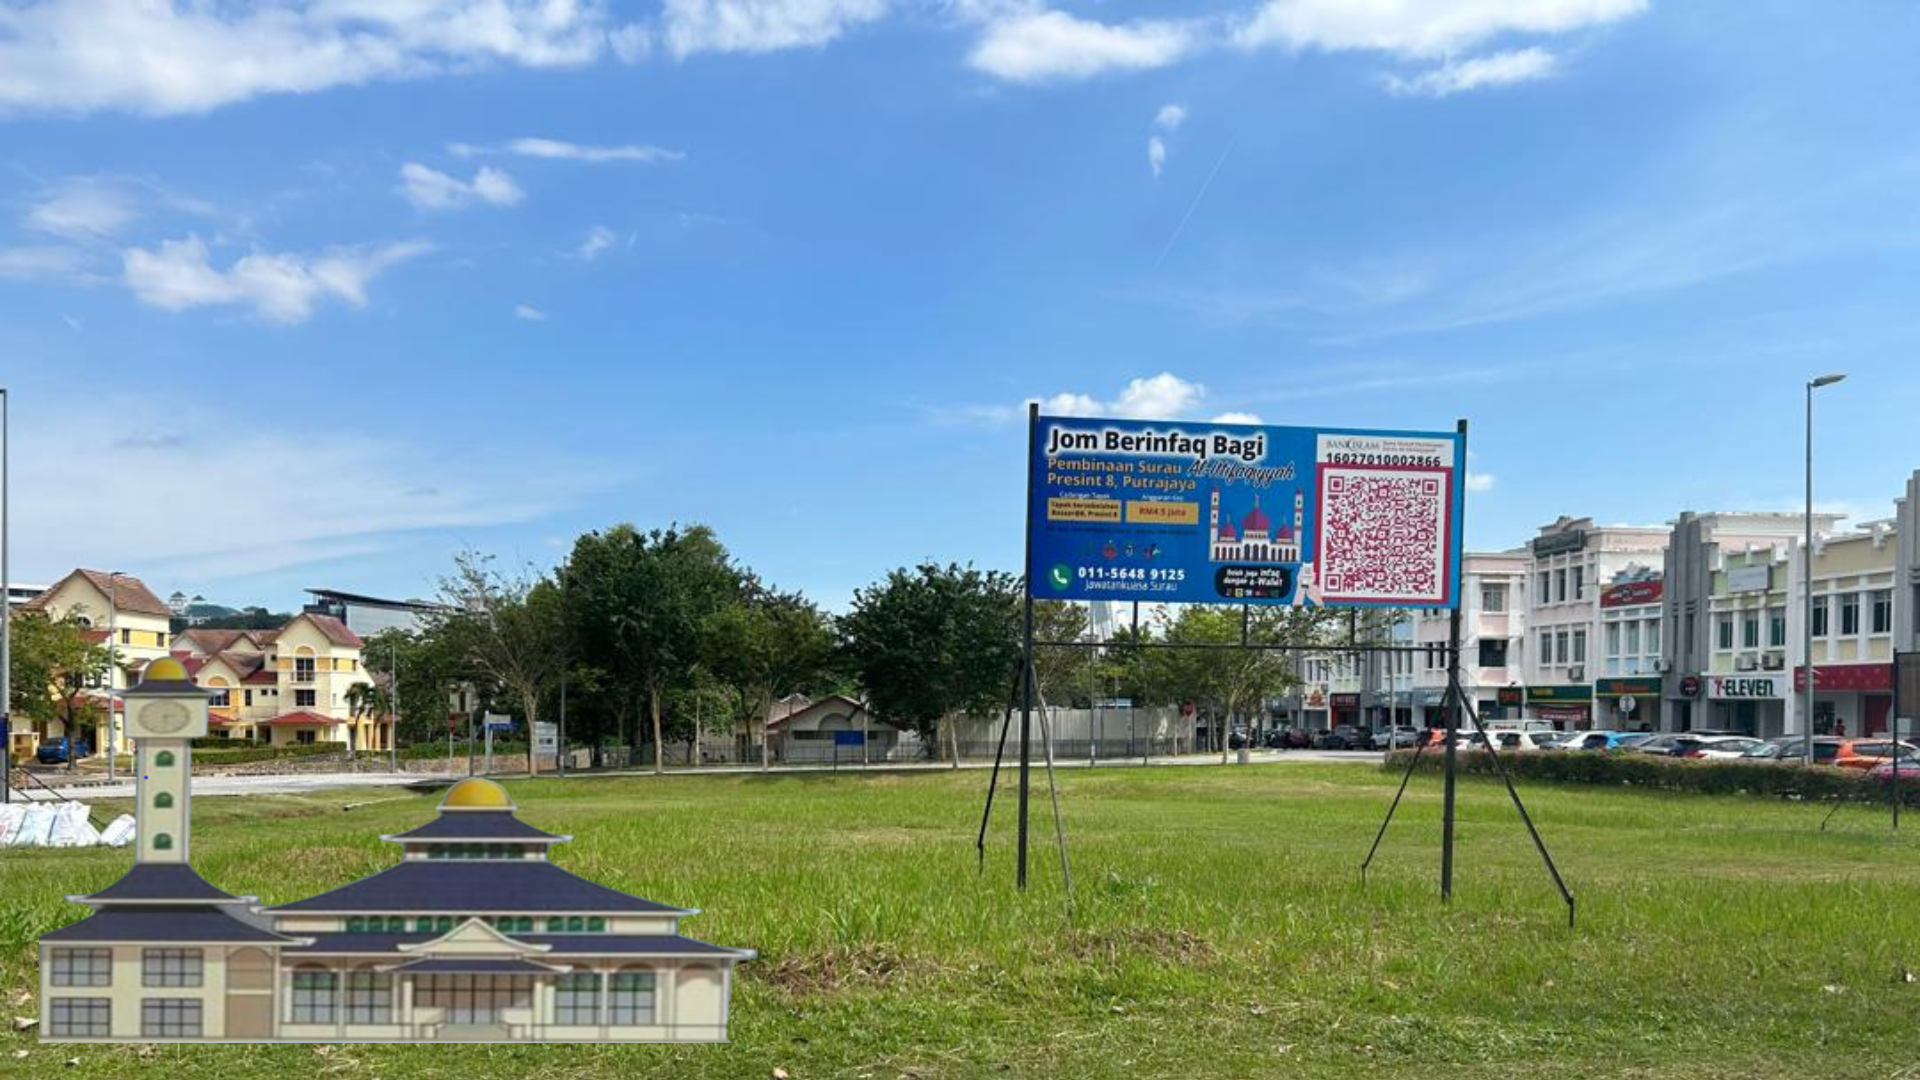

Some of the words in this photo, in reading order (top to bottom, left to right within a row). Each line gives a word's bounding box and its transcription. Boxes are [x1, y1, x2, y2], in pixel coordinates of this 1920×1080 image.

[1049, 429, 1098, 452] Jom
[1105, 431, 1207, 458] Berinfaq
[1213, 435, 1263, 462] Bagi
[1047, 457, 1134, 473] Pembinaan
[1138, 460, 1181, 474] Surau
[1326, 453, 1441, 467] 16027010002866
[1047, 472, 1101, 486] Presint
[1105, 475, 1118, 489] 8,
[1123, 476, 1196, 492] Putrajaya
[1078, 566, 1146, 579] 011-5648
[1150, 568, 1185, 580] 9125
[1084, 579, 1148, 591] Jawatankuasa
[1150, 581, 1178, 591] Surau
